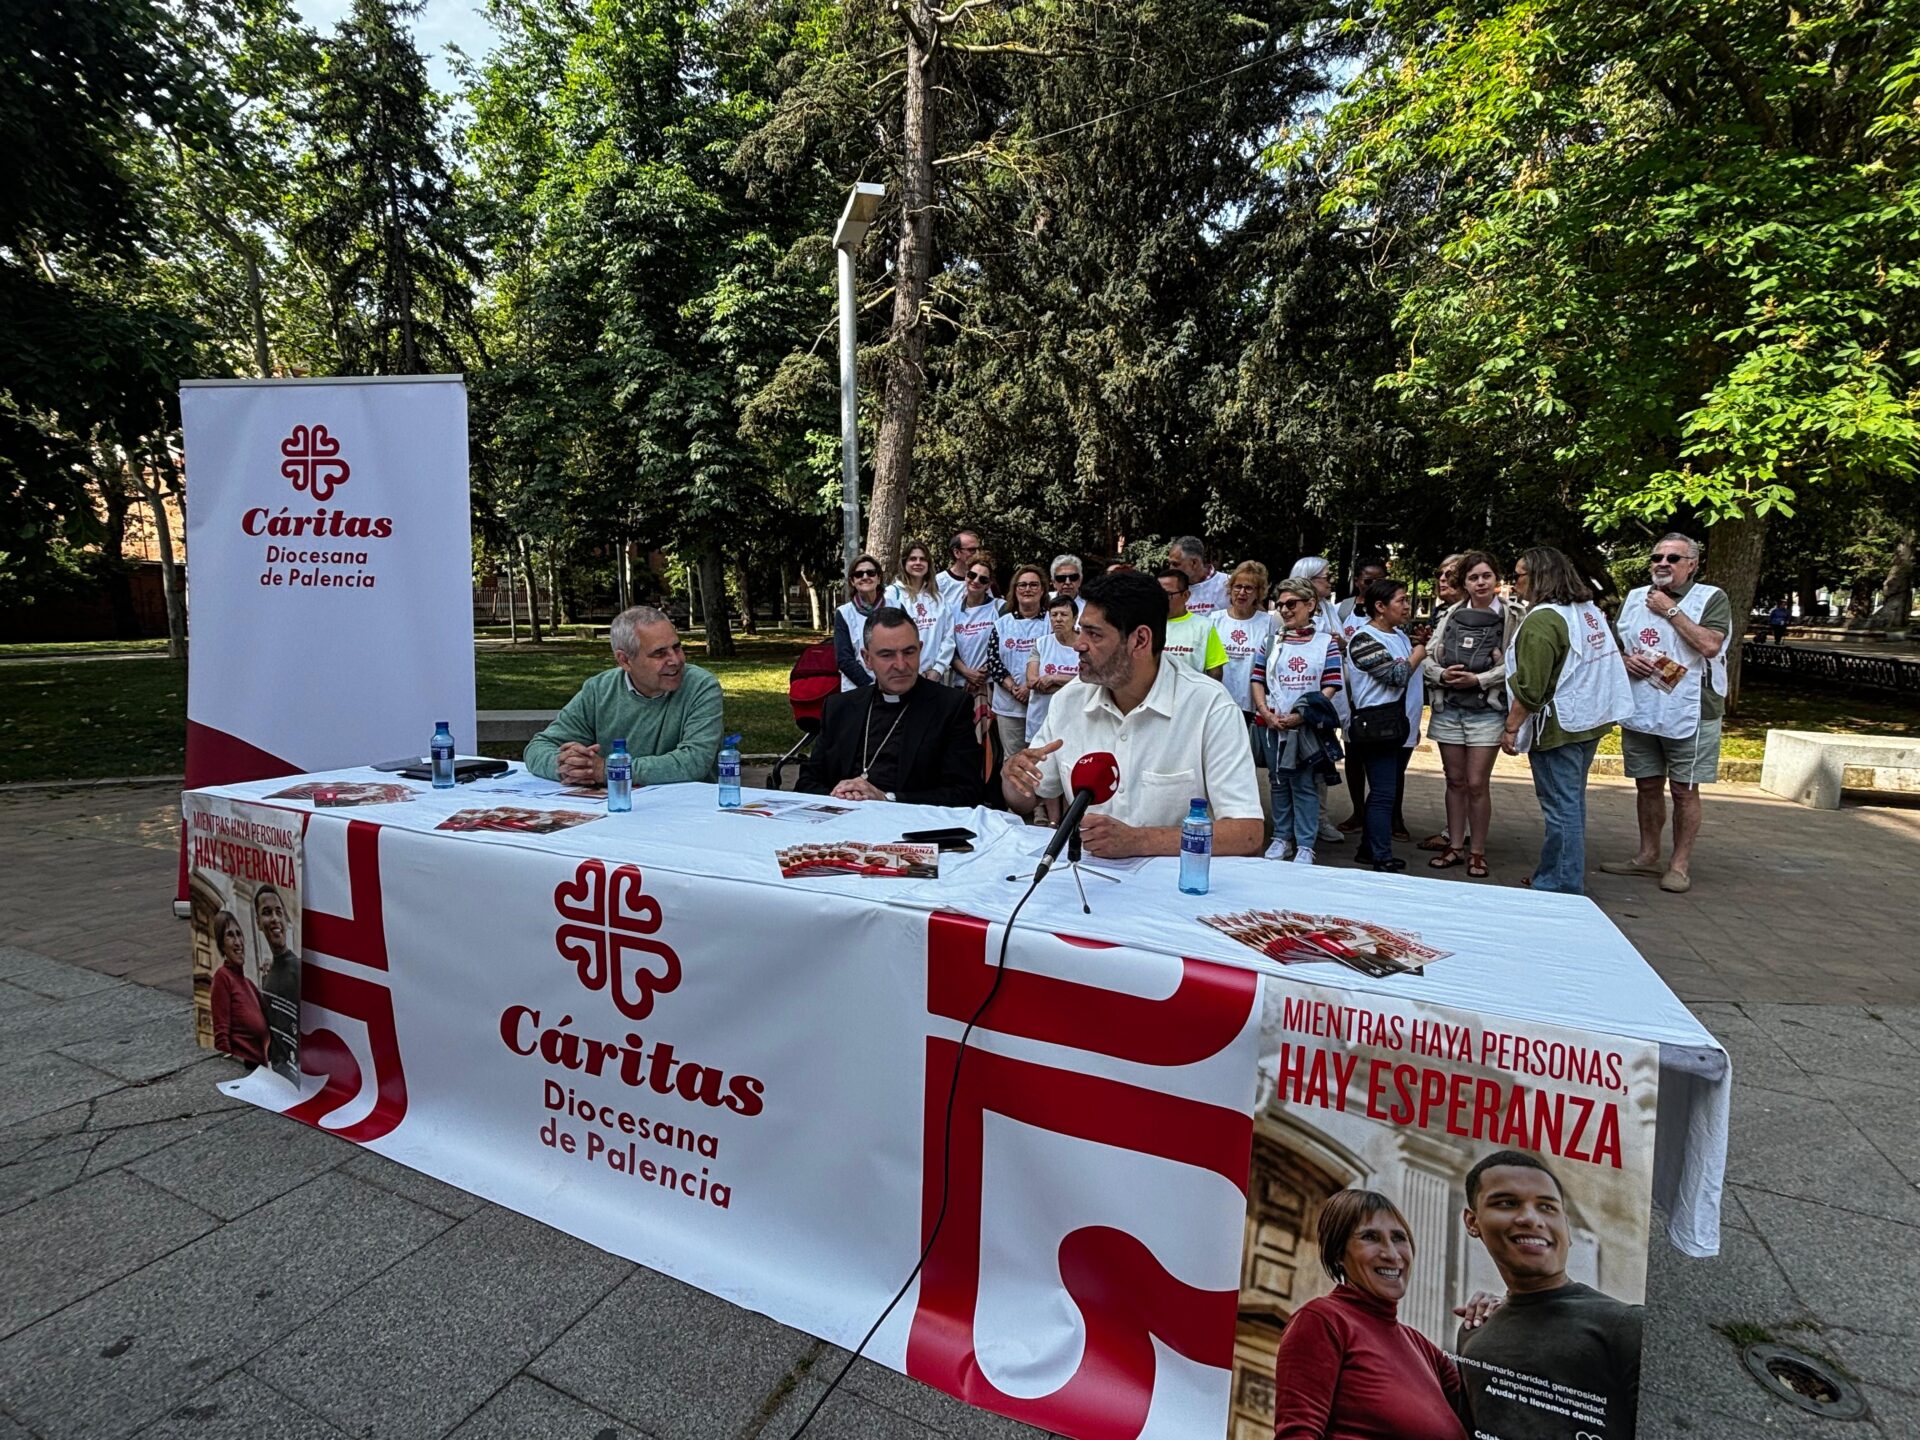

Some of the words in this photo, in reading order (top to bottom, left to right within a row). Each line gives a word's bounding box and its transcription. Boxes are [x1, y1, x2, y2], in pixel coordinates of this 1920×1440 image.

[241, 506, 393, 538] Cáritas
[260, 567, 283, 586] de
[288, 568, 376, 588] Palencia
[266, 545, 368, 565] Diocesana
[193, 811, 230, 836] MIENTRAS
[230, 818, 250, 840] HAYA
[251, 823, 295, 852] PERSONAS,
[194, 835, 217, 870] HAY
[221, 841, 296, 890] ESPERANZA
[500, 1004, 765, 1117] Cáritas
[1283, 996, 1404, 1051] MIENTRAS
[1411, 1018, 1473, 1064] HAYA
[1481, 1030, 1629, 1096] PERSONAS,
[544, 1078, 719, 1160] Diocesana
[1276, 1042, 1358, 1113] HAY
[1365, 1058, 1623, 1170] ESPERANZA
[539, 1116, 577, 1154] de
[587, 1130, 732, 1210] Palencia
[1442, 1350, 1481, 1368] Podemos
[1482, 1362, 1515, 1377] llamarlo
[1516, 1372, 1551, 1388] caridad,
[1551, 1383, 1607, 1405] generosidad
[1499, 1378, 1554, 1400] simplemente
[1555, 1394, 1606, 1415] humanidad.
[1485, 1384, 1517, 1400] Ayudar
[1519, 1394, 1528, 1404] lo
[1529, 1397, 1571, 1416] llevamos
[1572, 1410, 1606, 1427] dentro.
